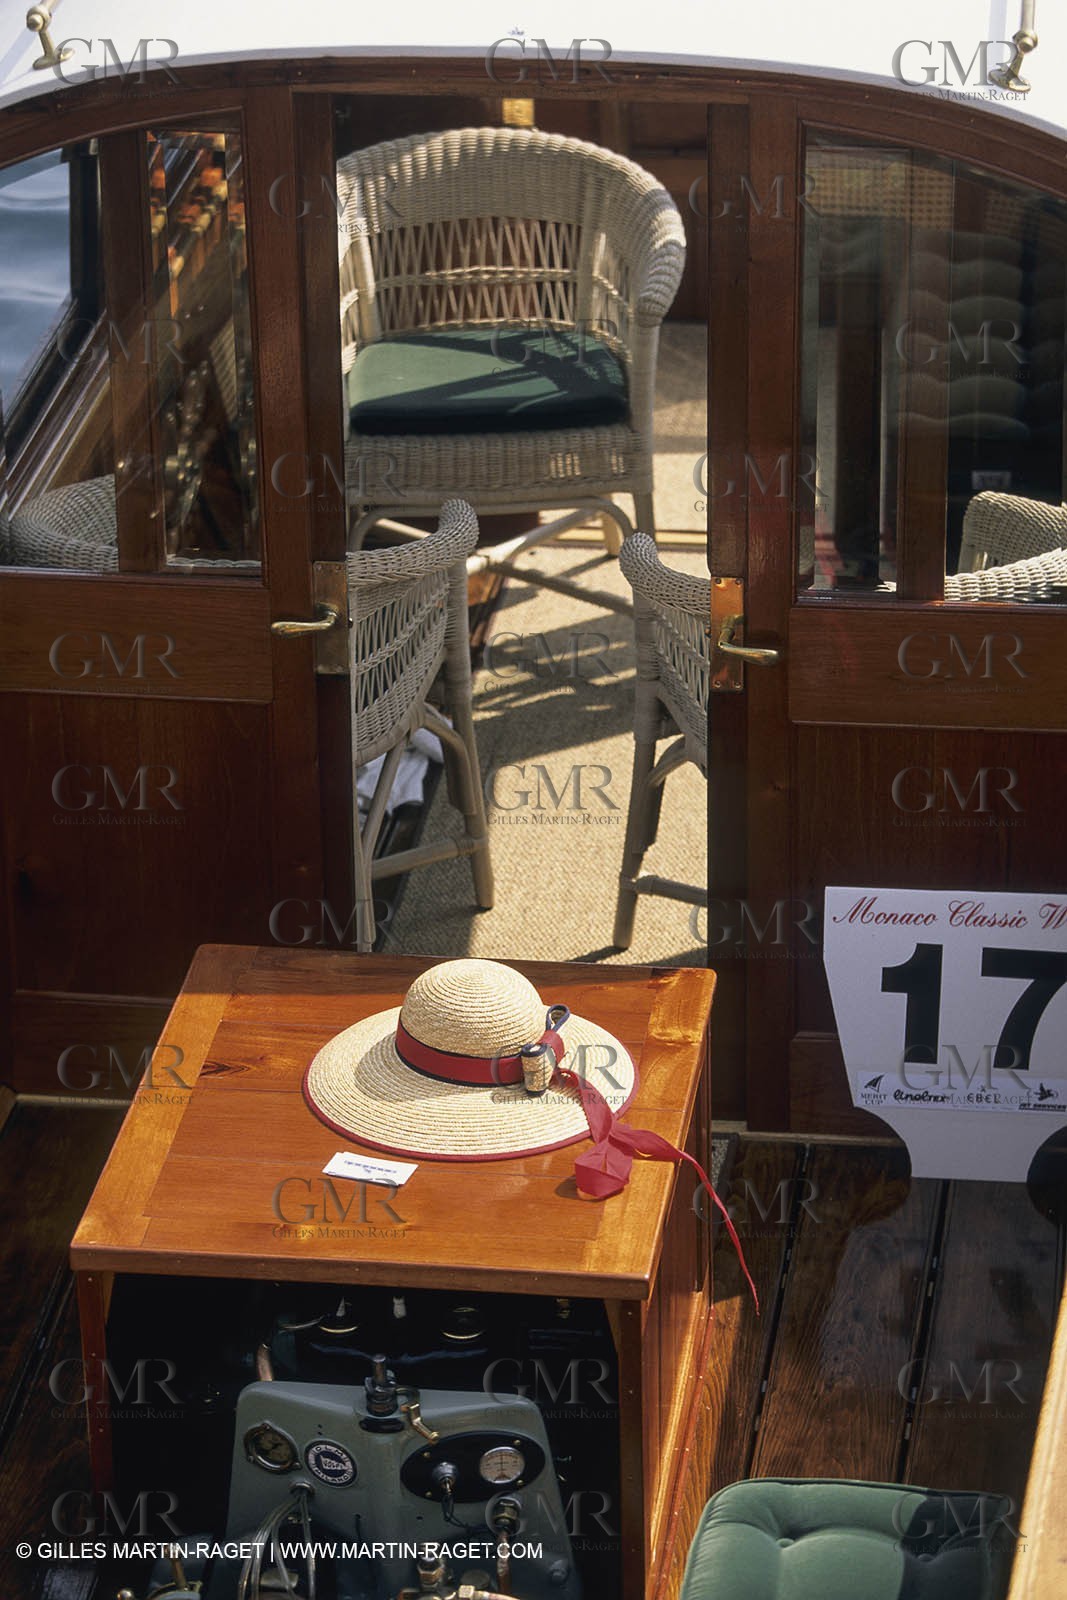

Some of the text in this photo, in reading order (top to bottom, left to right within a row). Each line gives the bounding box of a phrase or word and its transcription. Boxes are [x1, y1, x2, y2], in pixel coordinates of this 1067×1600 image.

[832, 896, 937, 925] Monaco
[948, 900, 1028, 929] Classic
[881, 942, 1067, 1071] 17
